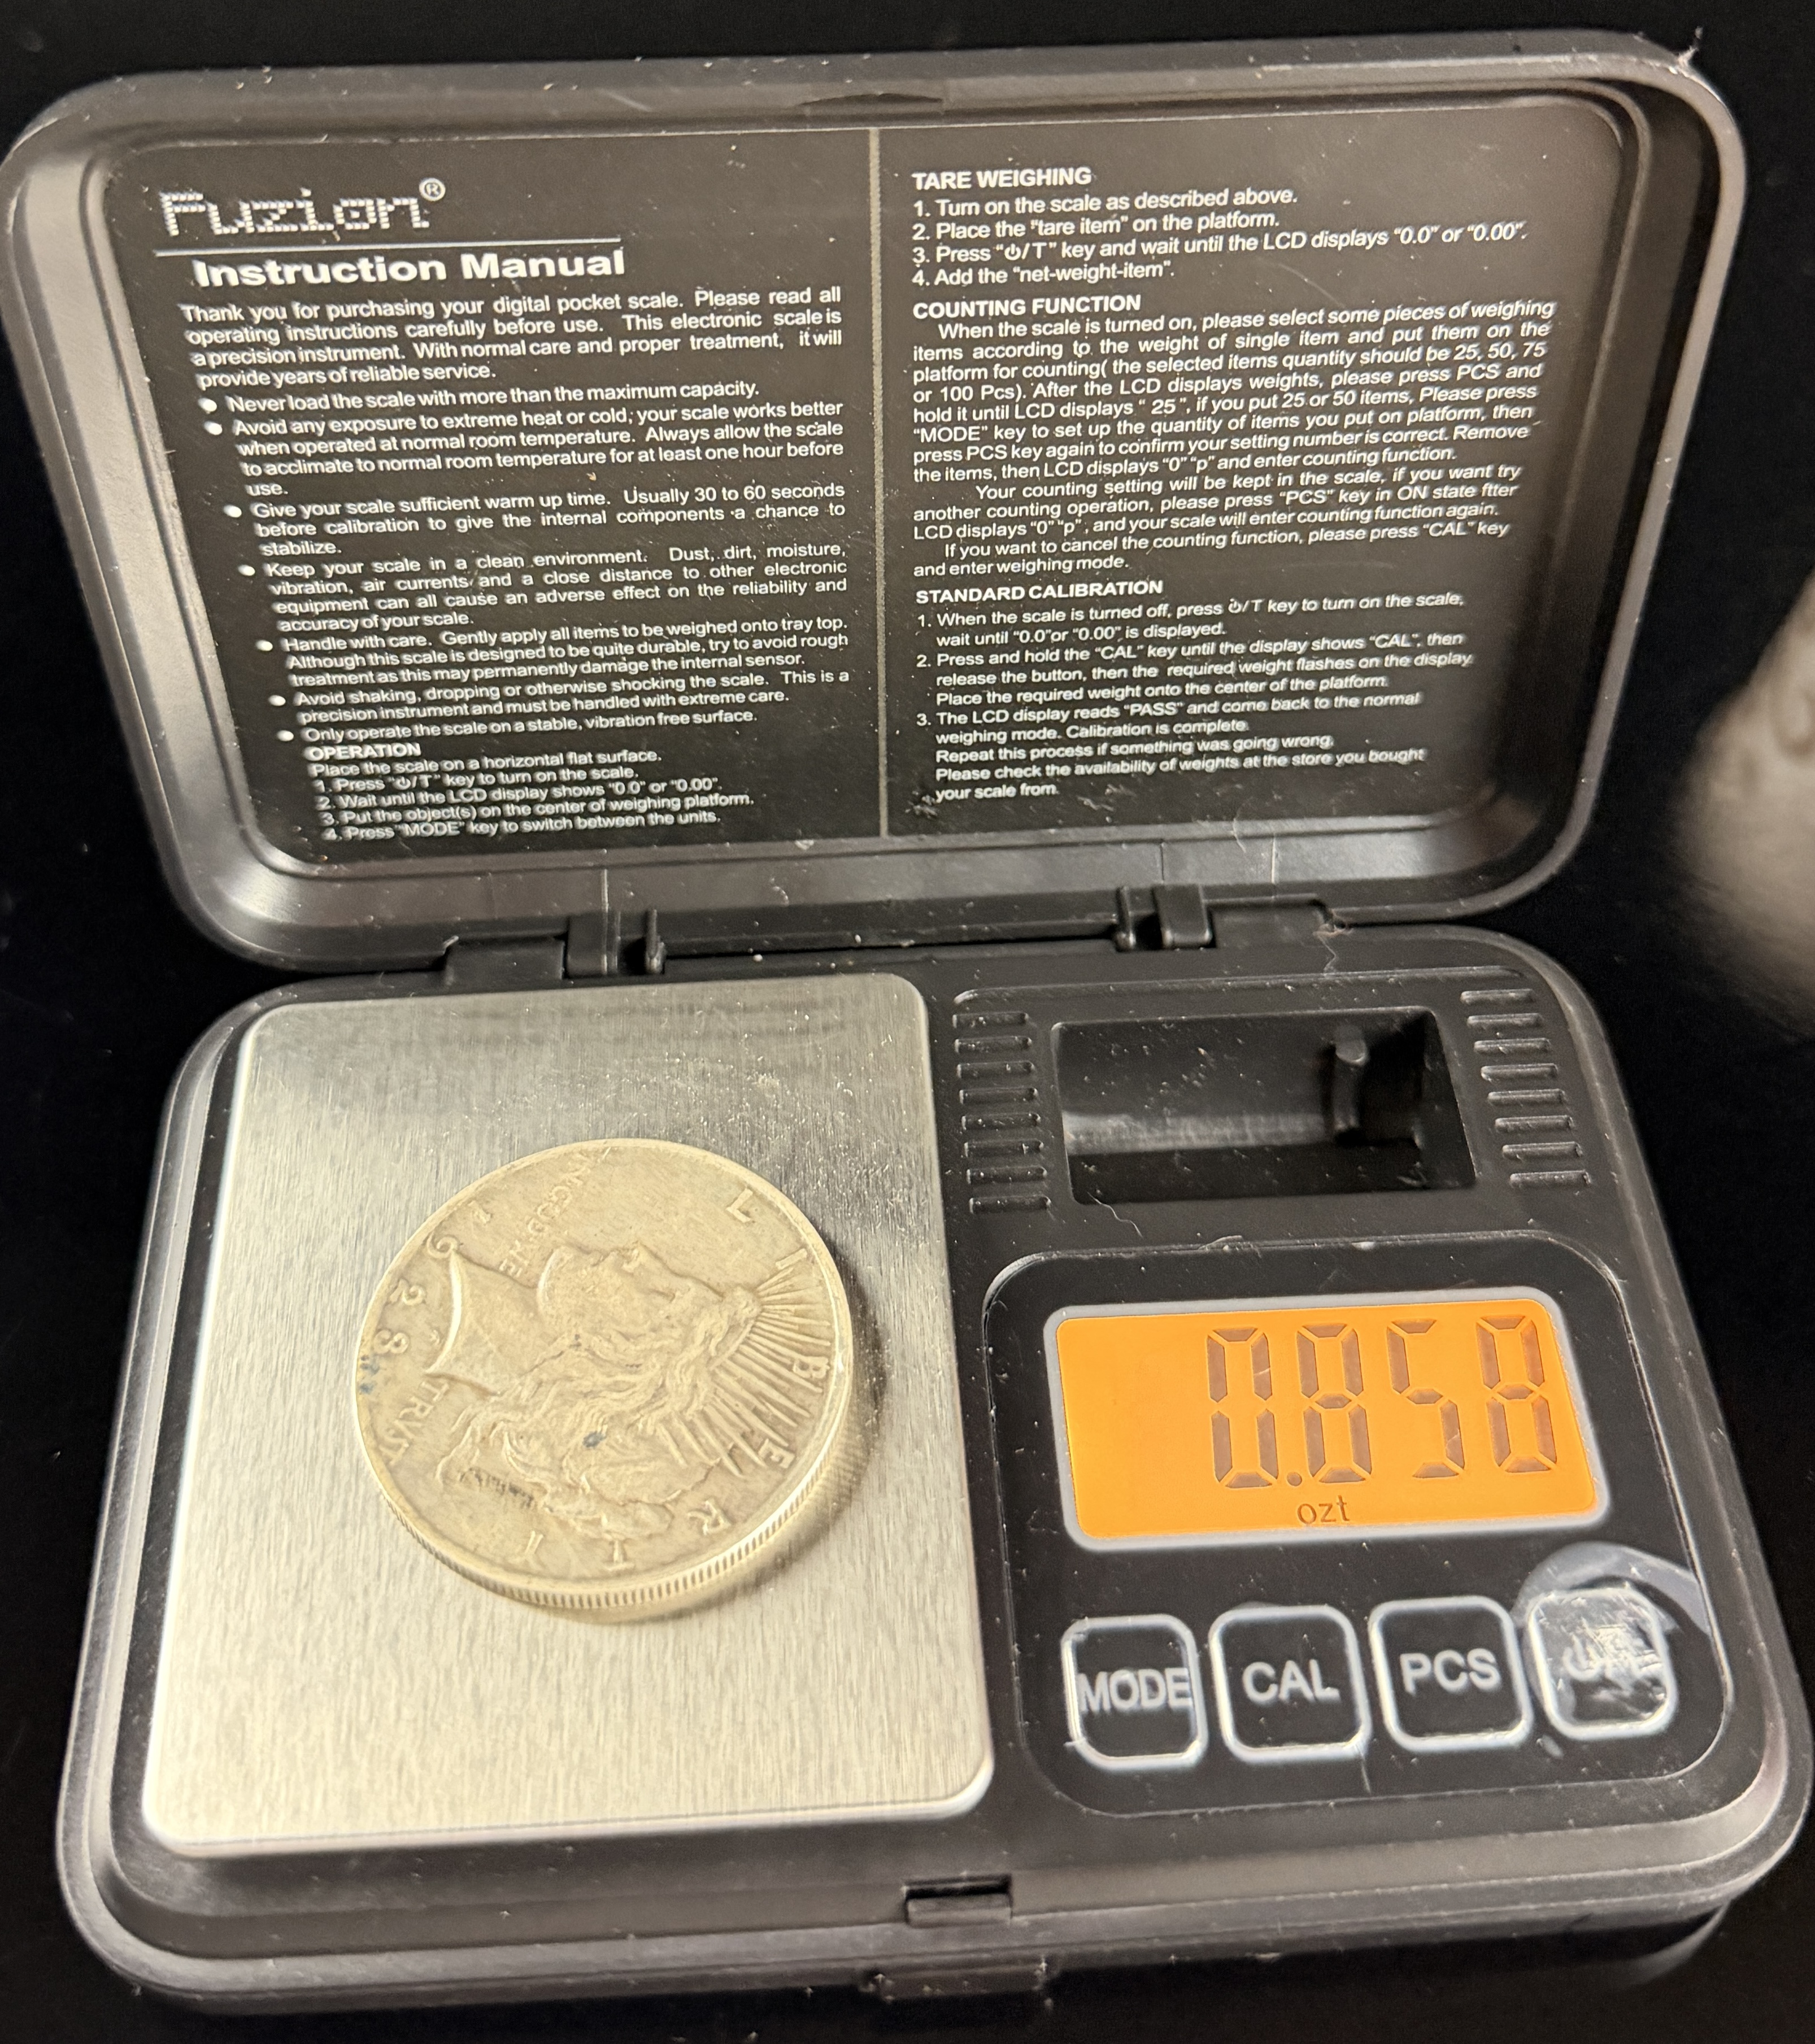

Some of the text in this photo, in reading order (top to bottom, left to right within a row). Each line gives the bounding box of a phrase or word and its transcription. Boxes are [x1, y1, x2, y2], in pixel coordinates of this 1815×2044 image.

[911, 167, 1092, 190] TARE WEIGHING
[913, 200, 931, 217] 1.
[984, 201, 1010, 215] on
[1014, 196, 1046, 214] the
[1050, 194, 1102, 213] scale
[1105, 195, 1130, 211] as
[1134, 188, 1229, 210] described
[1233, 186, 1298, 206] above.
[912, 223, 930, 241] 2.
[936, 222, 991, 239] Place
[995, 220, 1026, 238] the
[1132, 217, 1157, 232] on
[1162, 213, 1193, 231] the
[1197, 210, 1279, 234] platform.
[191, 249, 625, 287] Instruction Manual
[911, 269, 930, 286] 4.
[934, 268, 973, 287] Add
[977, 267, 1008, 284] the
[180, 285, 841, 325] Thank you for purchasing your digital pocket scale. Please read all
[912, 294, 1141, 320] COUNTING FUNCTION
[938, 299, 1557, 339] When the scale is turned on, please select some pieces of weighing
[186, 307, 842, 348] operating instructions carefully before use. This electronic scale is
[227, 380, 759, 413] Never load the scale with more than the maximum capacity.
[913, 363, 1544, 403] or 100 Pcs). After the LCD displays weights, please press PCS and
[250, 481, 846, 520] Give your scale sufficient warm up time. Usually 30 to 60 seconds
[265, 543, 850, 579] Keep your scale in a clean environment. Dust, dirt, moisture,
[916, 579, 1163, 604] STANDARD CALIBRATION
[916, 654, 932, 668] 2.
[937, 653, 985, 666] Press
[988, 650, 1020, 665] and
[1024, 648, 1060, 663] hold
[1064, 648, 1091, 661] the
[1147, 644, 1178, 660] key
[1181, 642, 1216, 656] until
[1219, 641, 1247, 656] the
[1249, 638, 1309, 655] display
[1311, 637, 1366, 651] shows
[1427, 633, 1465, 646] then
[916, 713, 932, 726] 3.
[935, 712, 968, 725] The
[972, 709, 1009, 724] LCD
[1012, 708, 1070, 724] display
[1073, 705, 1121, 719] reads
[1186, 700, 1220, 714] and
[1221, 700, 1269, 713] come
[1270, 696, 1311, 711] back
[1314, 696, 1331, 709] to
[1334, 695, 1361, 708] the
[1363, 692, 1422, 707] normal
[303, 728, 345, 744] Only
[345, 725, 411, 742] operate
[413, 724, 442, 737] the
[443, 722, 488, 736] scale
[489, 723, 512, 734] on
[513, 721, 526, 733] a
[584, 714, 656, 730] vibration
[656, 712, 691, 726] free
[306, 743, 422, 761] OPERATION
[1206, 1314, 1557, 1489] 0.858
[1296, 1494, 1351, 1524] ozt
[1242, 1658, 1341, 1705] CAL
[1399, 1648, 1501, 1695] PCS
[1077, 1667, 1194, 1714] MODE
